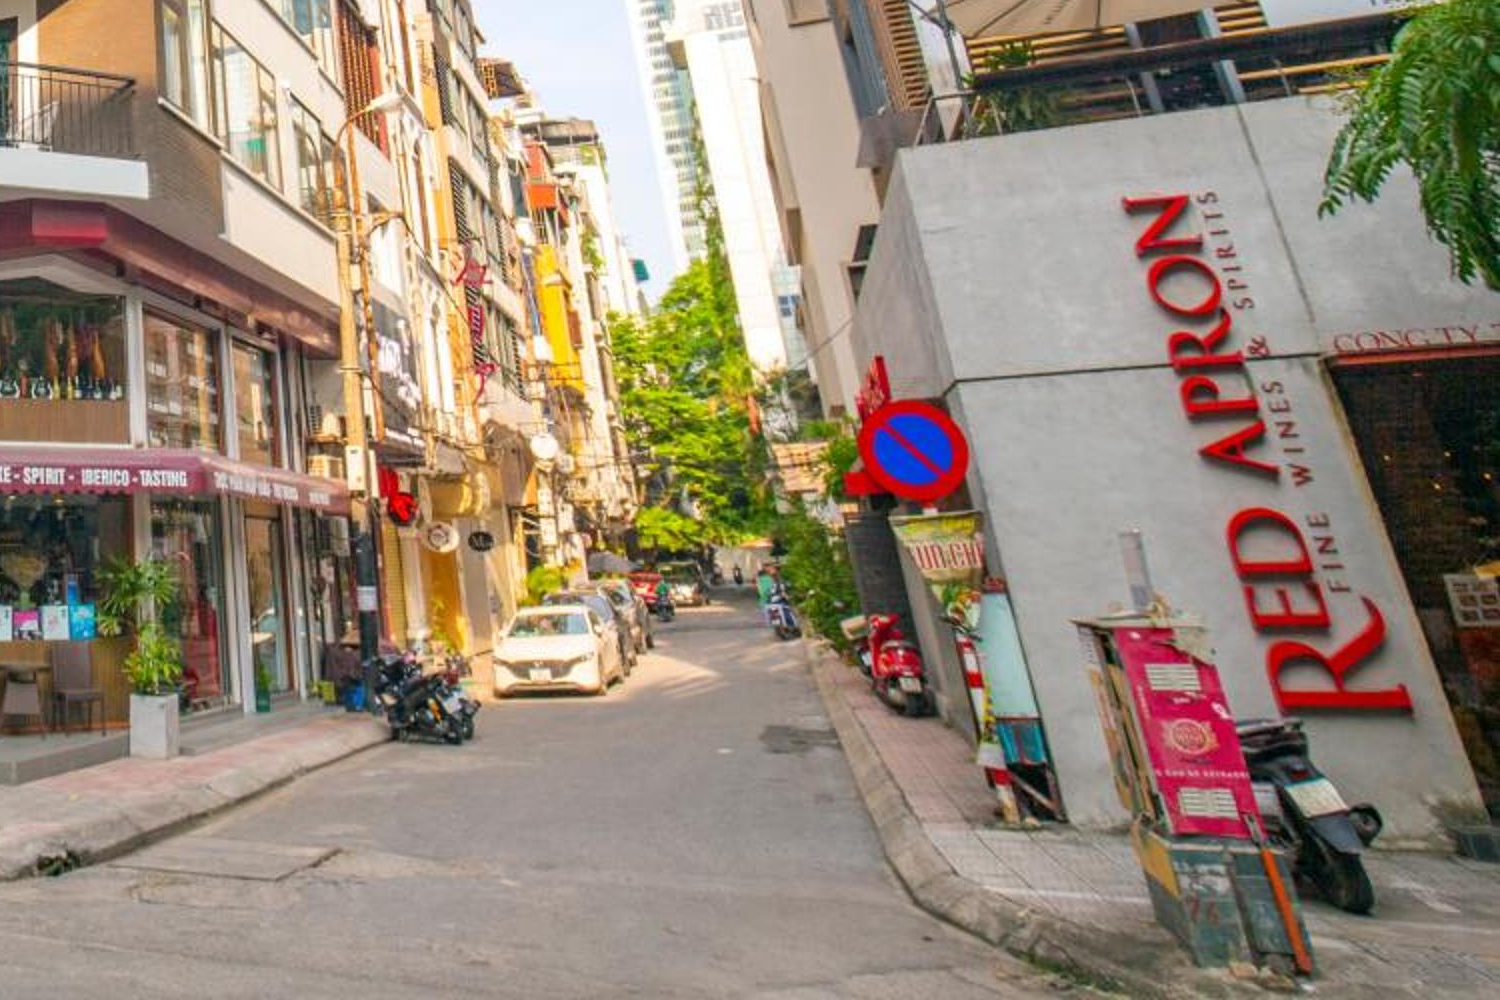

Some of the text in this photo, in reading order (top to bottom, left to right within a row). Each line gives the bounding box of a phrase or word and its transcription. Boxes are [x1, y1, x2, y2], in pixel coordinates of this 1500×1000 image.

[23, 467, 66, 485] SPIRIT
[81, 468, 129, 486] IBERICO
[139, 470, 188, 487] TASTING
[1123, 194, 1414, 714] RED APRON
[1197, 191, 1352, 594] FINE WINES & SPIRITS
